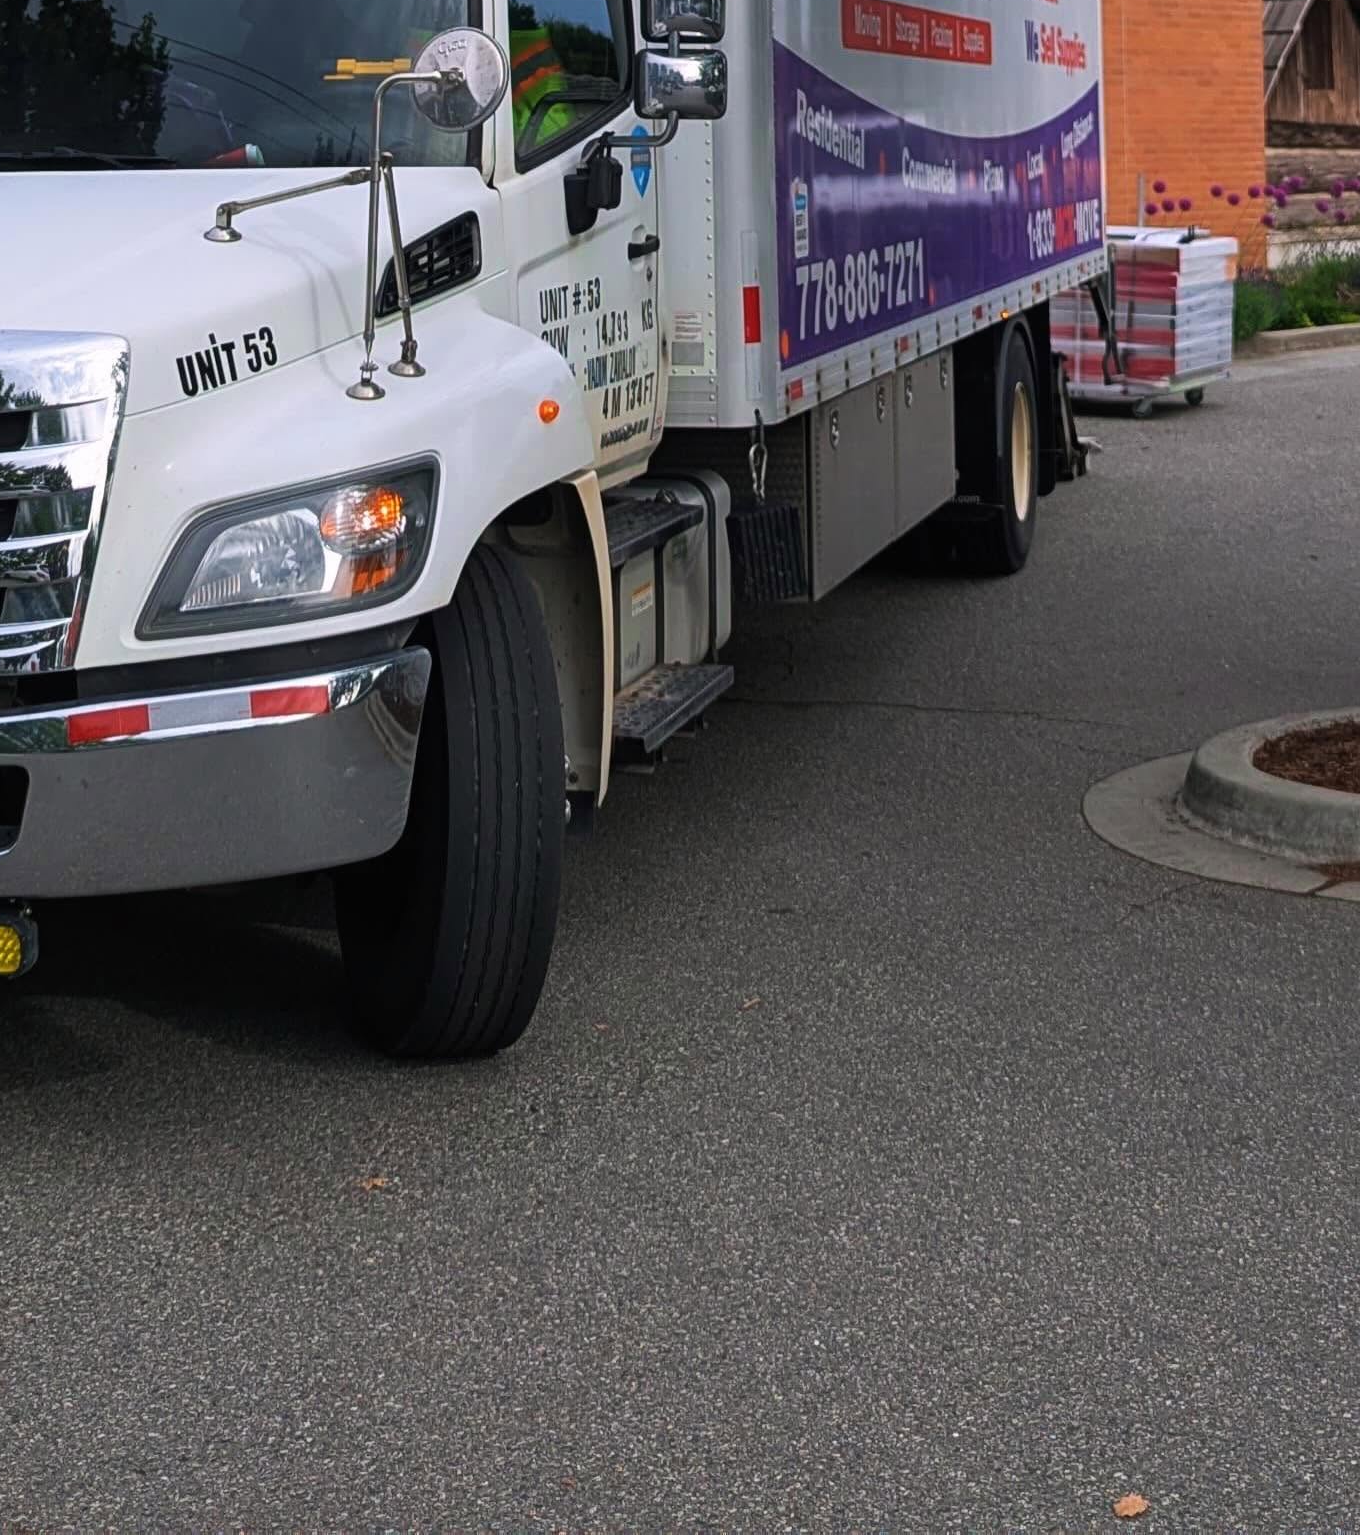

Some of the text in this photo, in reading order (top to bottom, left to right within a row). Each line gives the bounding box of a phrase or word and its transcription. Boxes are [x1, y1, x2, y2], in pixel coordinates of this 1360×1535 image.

[1024, 19, 1039, 63] We
[795, 89, 865, 170] Residential
[901, 146, 956, 194] Commercial
[539, 286, 569, 324] UNIT
[641, 298, 654, 332] KG
[243, 327, 277, 372] 53
[602, 388, 609, 419] 4
[611, 385, 621, 419] M
